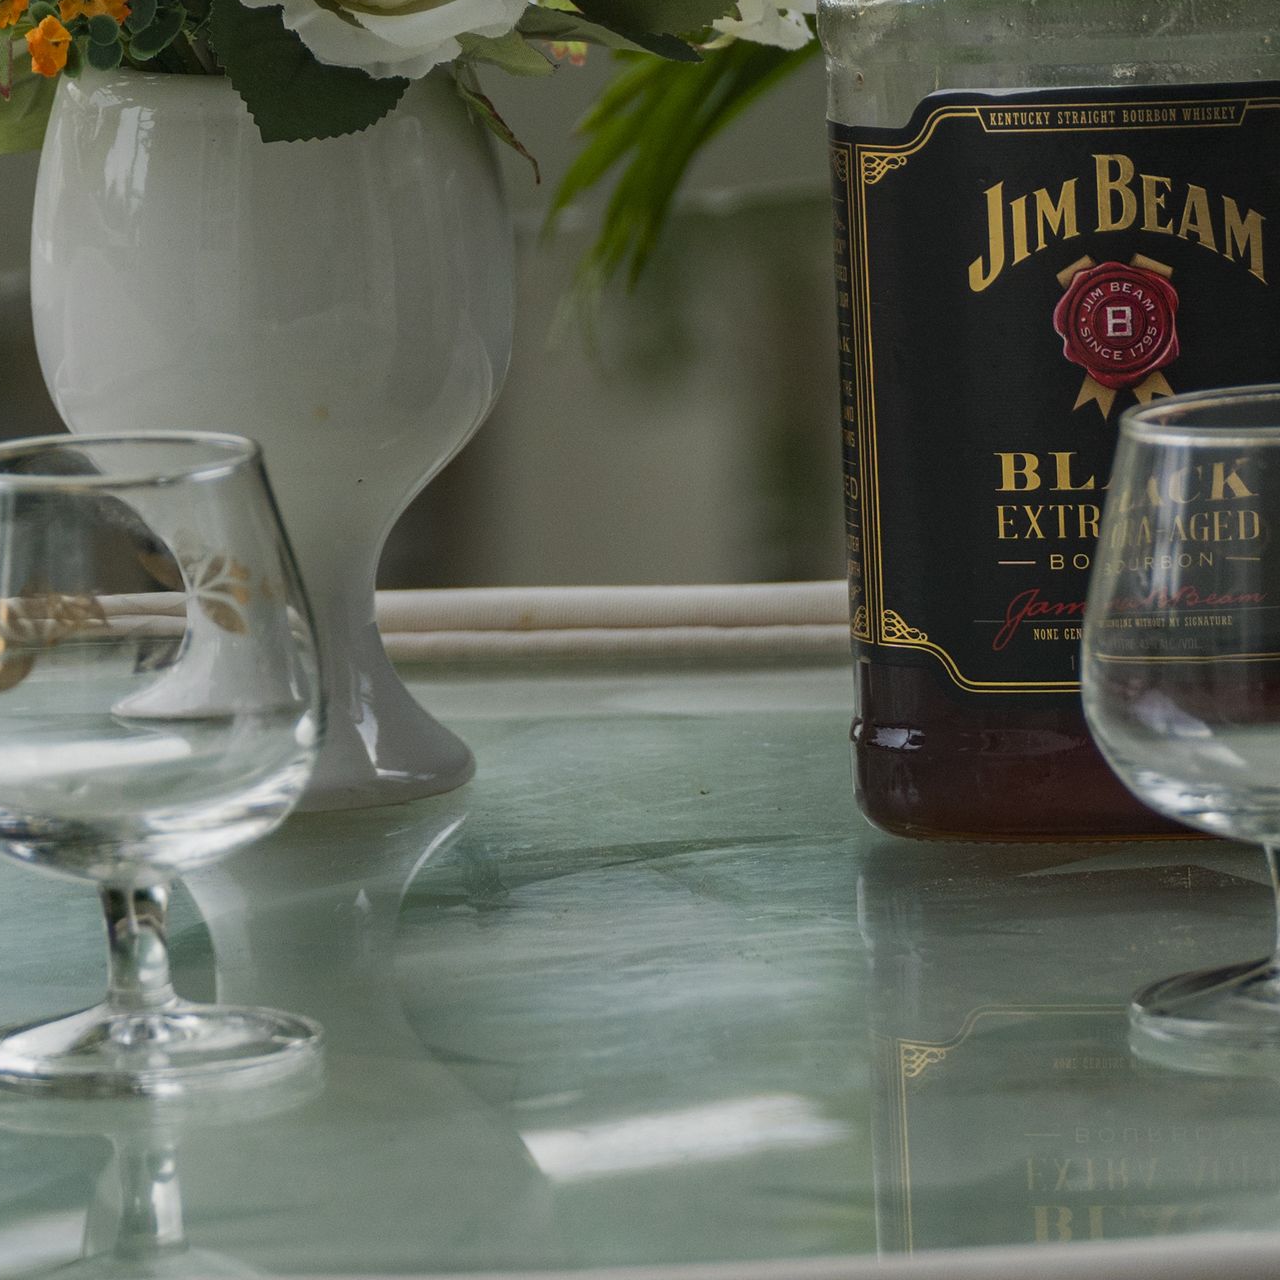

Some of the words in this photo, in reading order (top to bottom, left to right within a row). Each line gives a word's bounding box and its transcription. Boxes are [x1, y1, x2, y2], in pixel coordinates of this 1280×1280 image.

[989, 111, 1051, 126] KENTUCKY
[1057, 110, 1116, 125] STRAIGHT
[1122, 108, 1177, 123] BOURBON
[1182, 106, 1236, 121] WHISKEY
[968, 177, 1081, 292] JIM
[1091, 153, 1268, 285] BEAM
[1082, 287, 1104, 312] JIM
[1110, 282, 1155, 311] BEAM
[1106, 306, 1133, 337] B
[1080, 326, 1123, 361] SINCE
[1130, 326, 1157, 357] 1795
[1033, 628, 1059, 641] NONE
[1184, 615, 1233, 627] SIGNATURE
